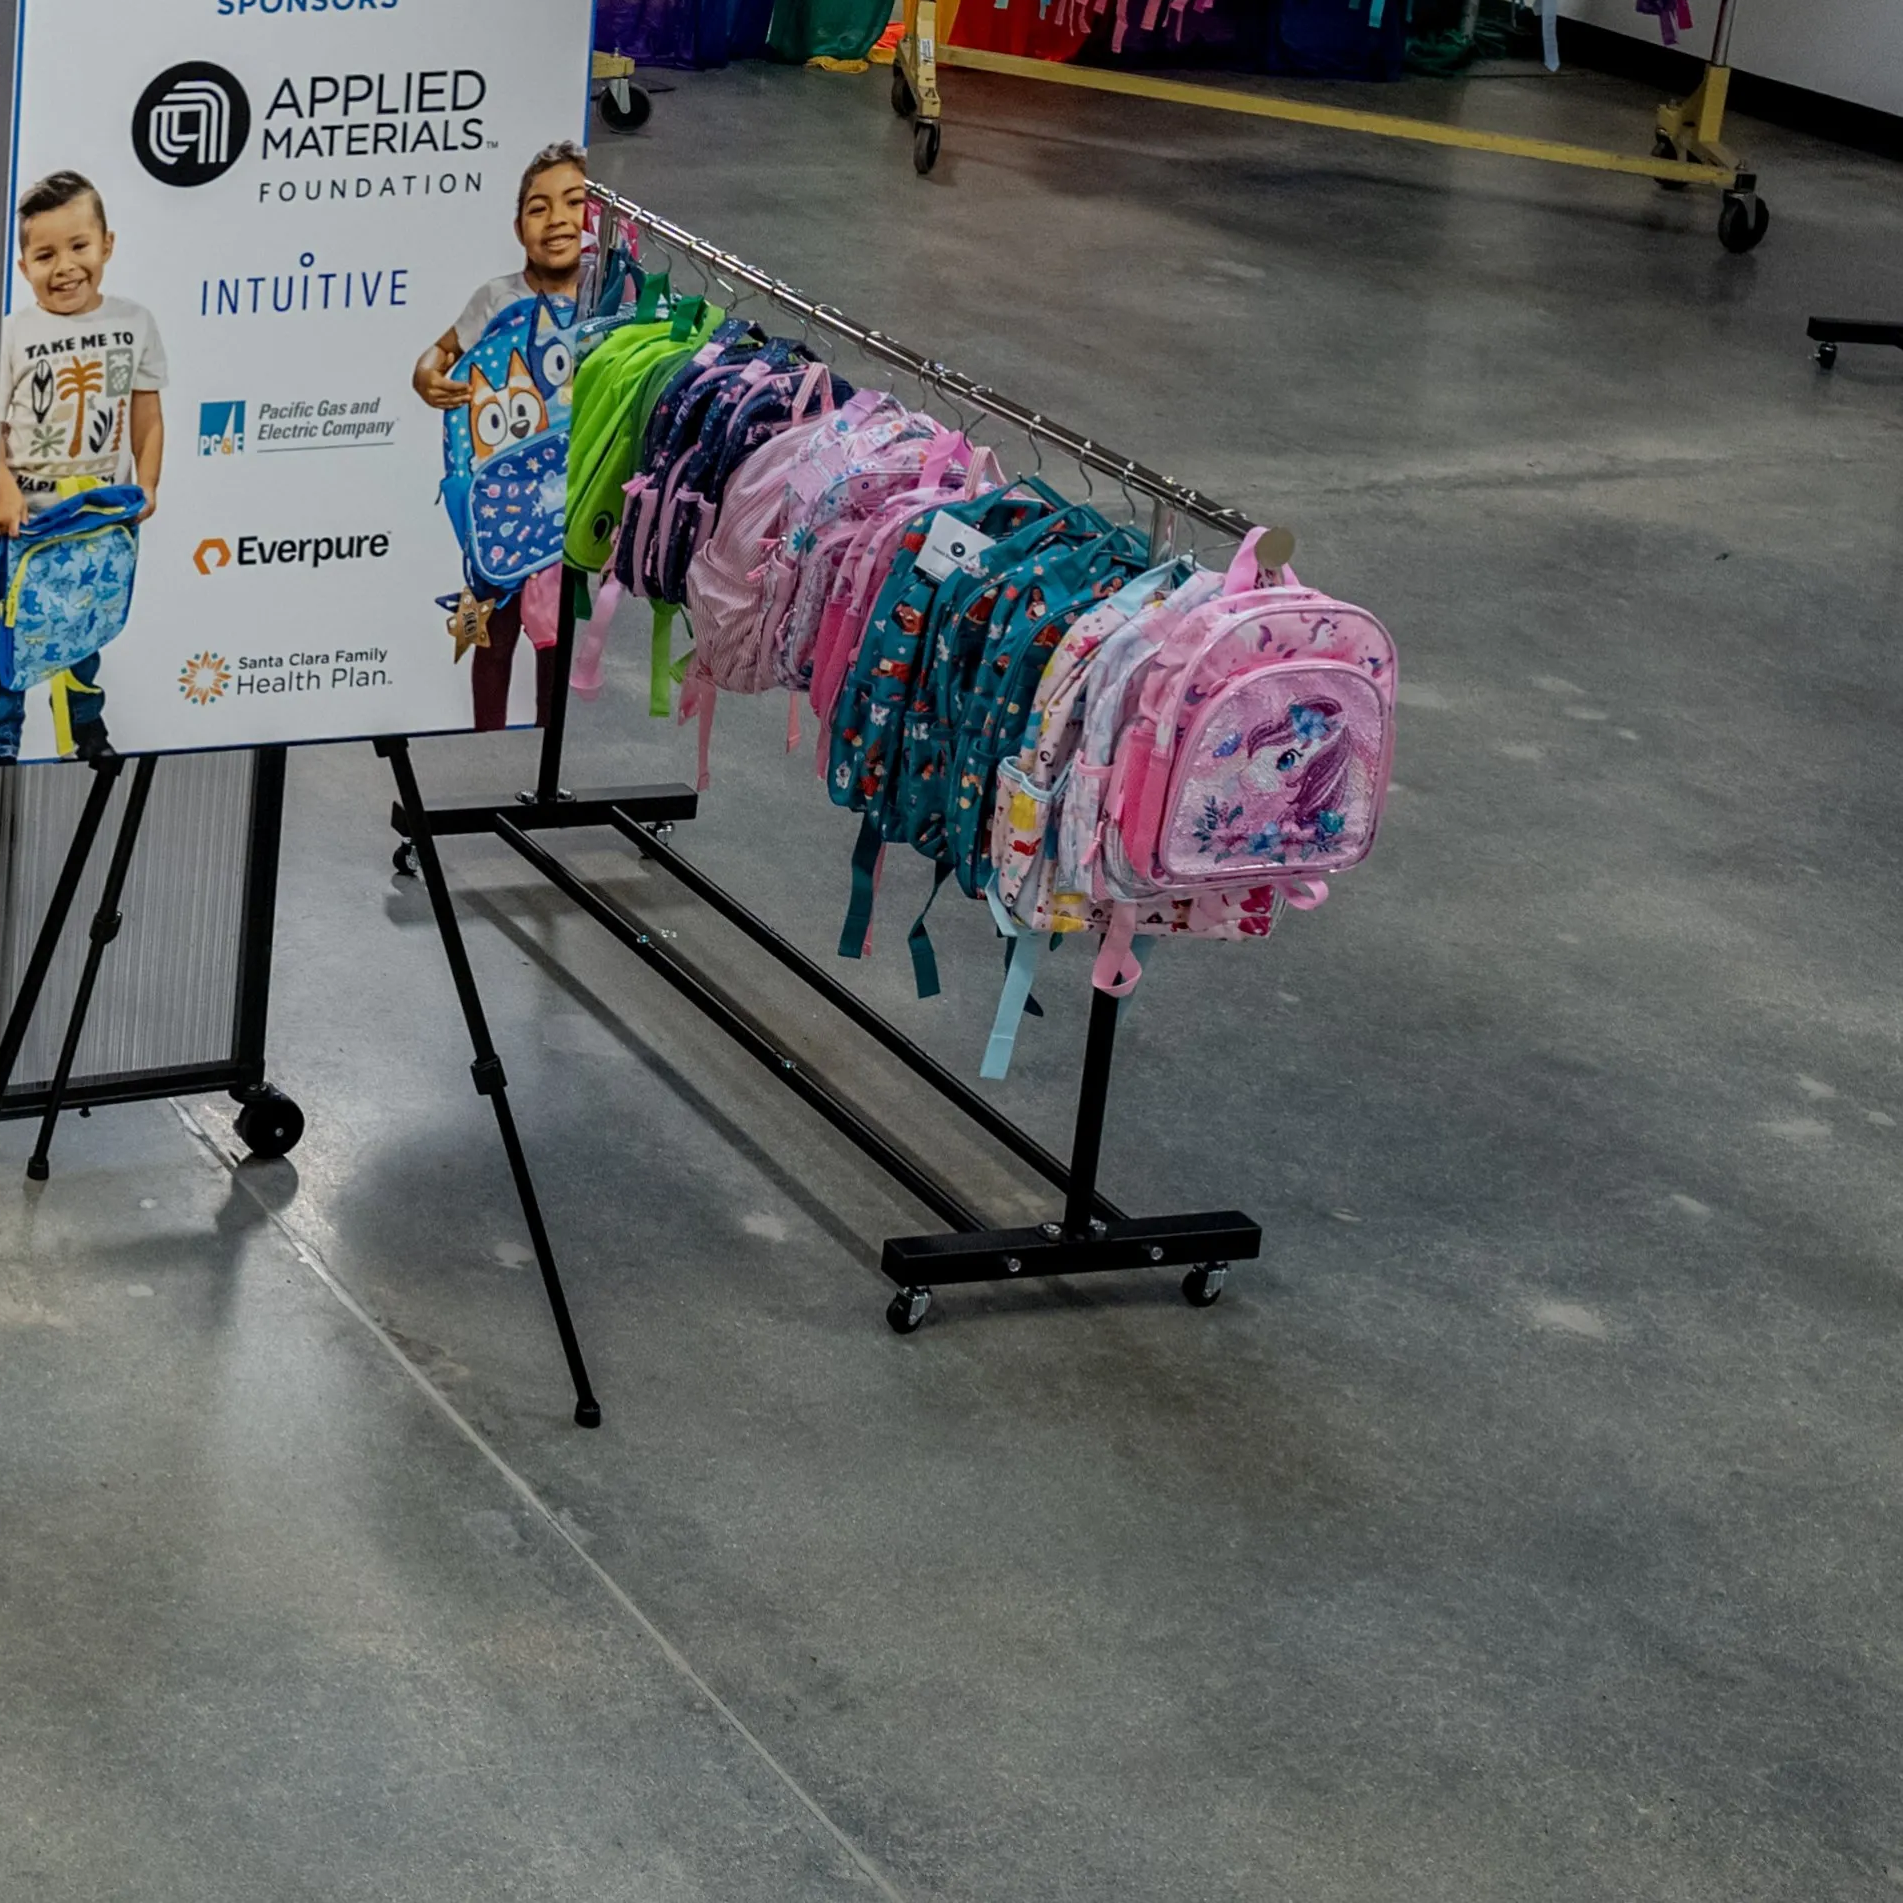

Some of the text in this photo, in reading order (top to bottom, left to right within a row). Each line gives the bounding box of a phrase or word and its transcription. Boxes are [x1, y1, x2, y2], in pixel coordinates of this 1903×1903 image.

[265, 69, 487, 121] APPLIED
[259, 171, 483, 203] FOUNDATION
[200, 251, 409, 316] INTUITIVE
[25, 330, 135, 360] TAKE ME TO
[258, 396, 381, 421] Pacific Gas and
[257, 419, 395, 441] Electric Company
[197, 433, 245, 456] PG&E
[237, 532, 390, 568] Everpure
[238, 647, 388, 671] Santa Clara Family
[236, 669, 321, 696] Health
